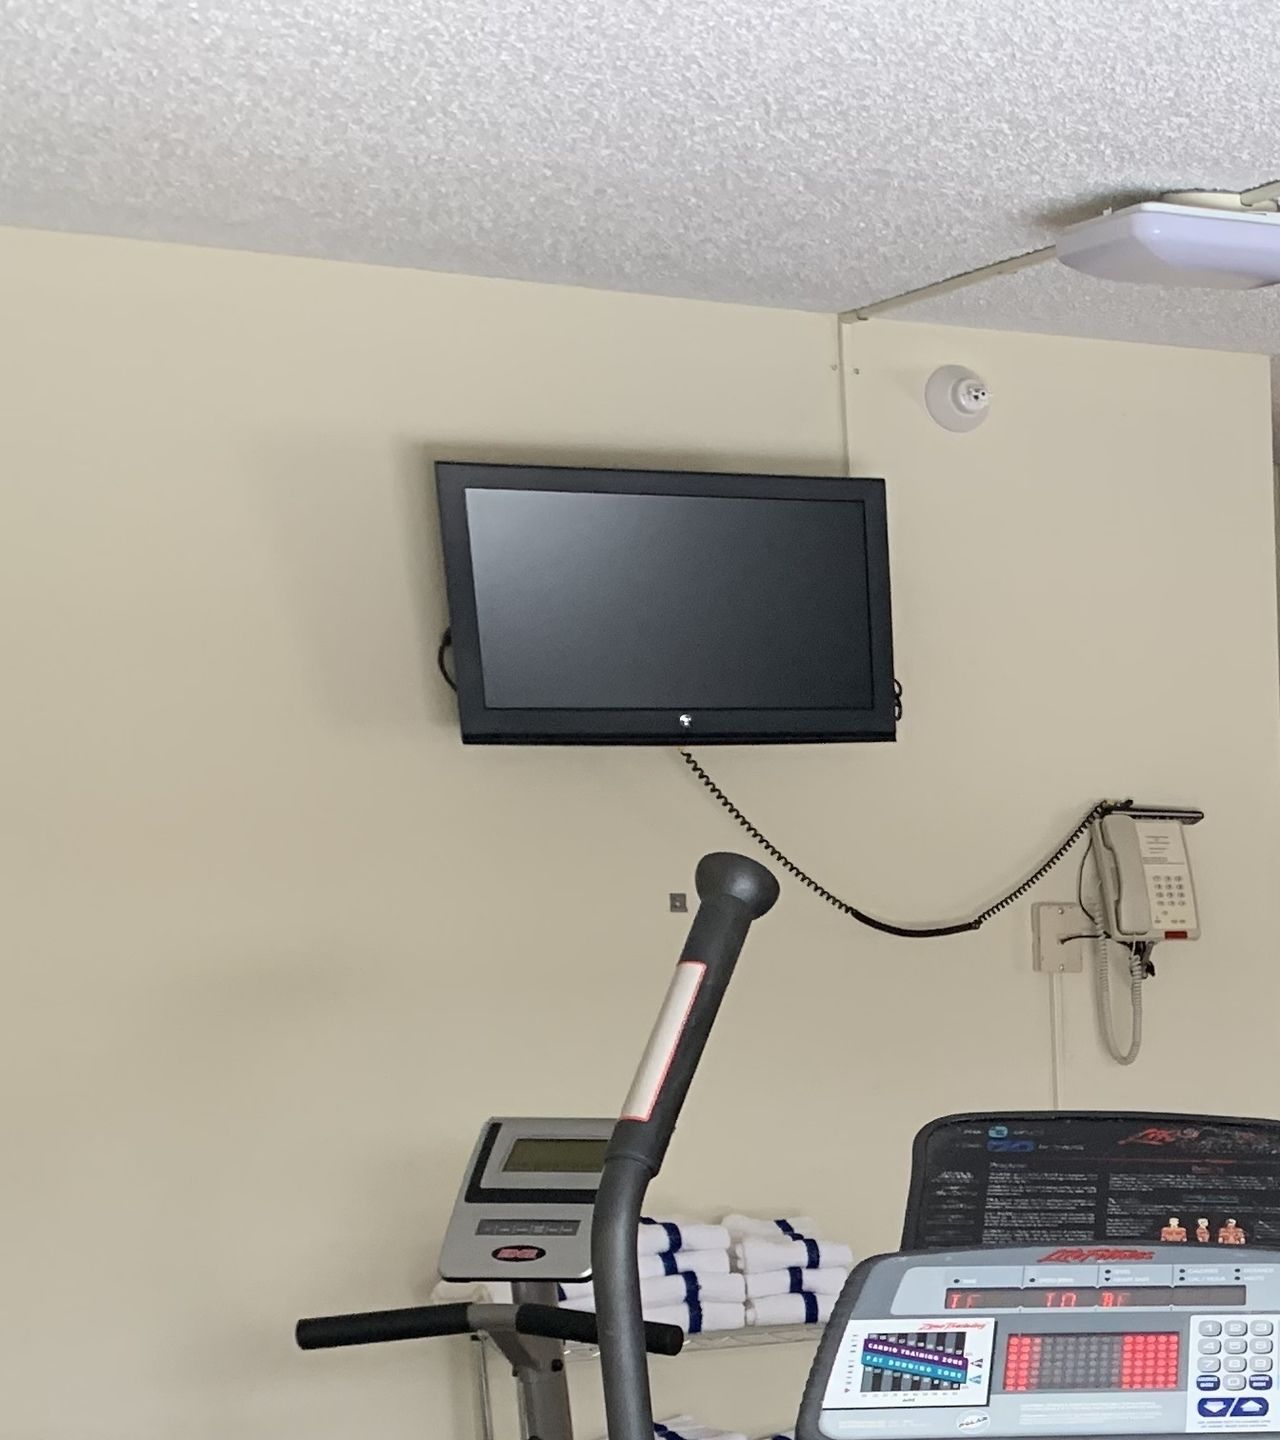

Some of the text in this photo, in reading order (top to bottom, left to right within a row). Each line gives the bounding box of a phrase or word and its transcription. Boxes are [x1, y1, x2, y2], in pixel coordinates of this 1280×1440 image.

[867, 1342, 964, 1366] CARDIO TRAINING ZONE
